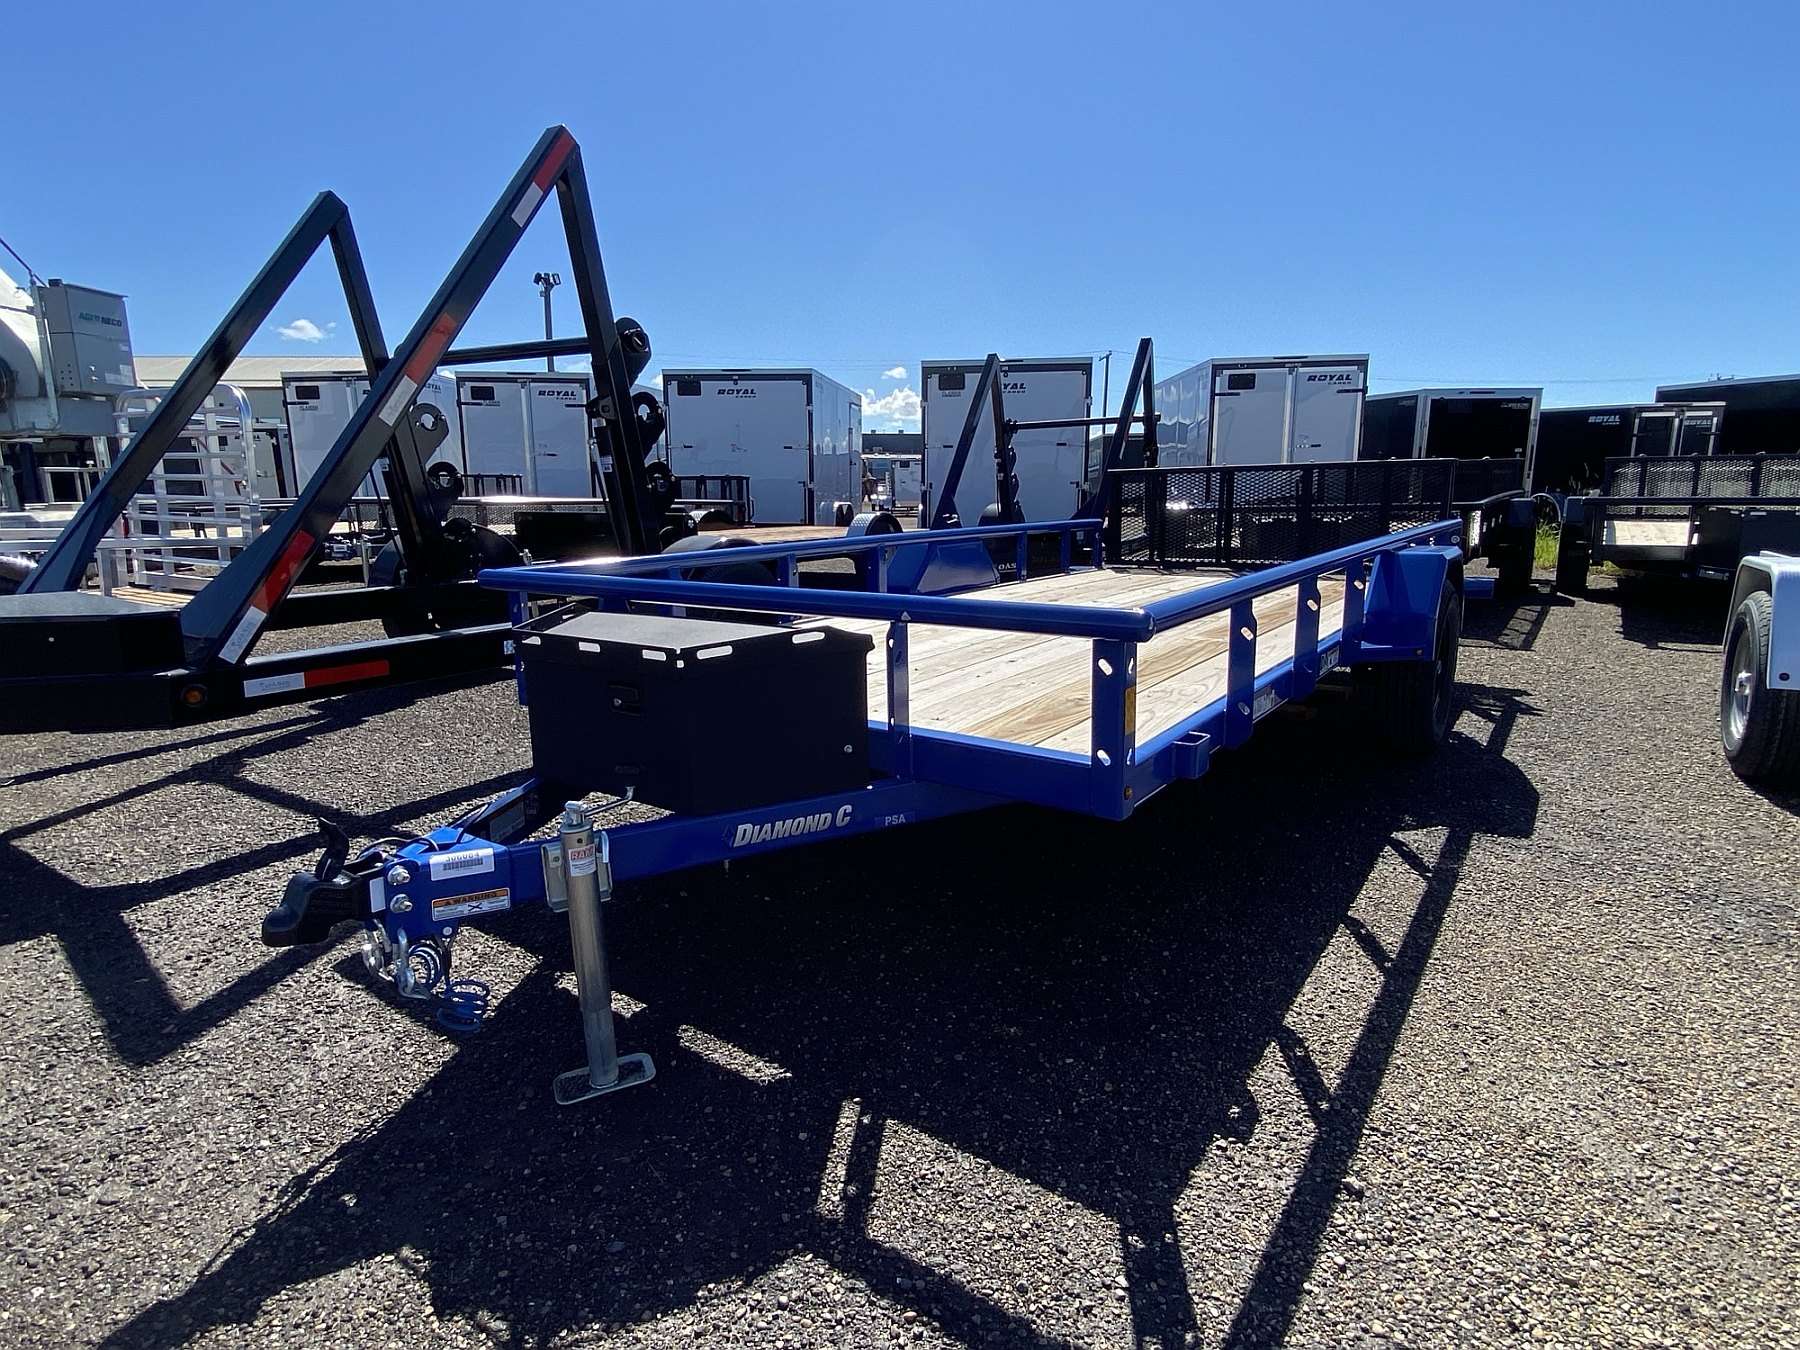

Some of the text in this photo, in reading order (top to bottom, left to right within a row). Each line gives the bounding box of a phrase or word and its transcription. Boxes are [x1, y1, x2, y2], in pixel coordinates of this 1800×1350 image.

[1307, 374, 1352, 382] ROYAL
[538, 389, 577, 397] ROYAL
[717, 388, 757, 396] ROYAL
[1587, 415, 1621, 423] ROYAL
[1684, 419, 1712, 427] ROYAL
[884, 813, 906, 826] PSA
[733, 804, 853, 847] DIAMOND C
[571, 846, 594, 861] RAM
